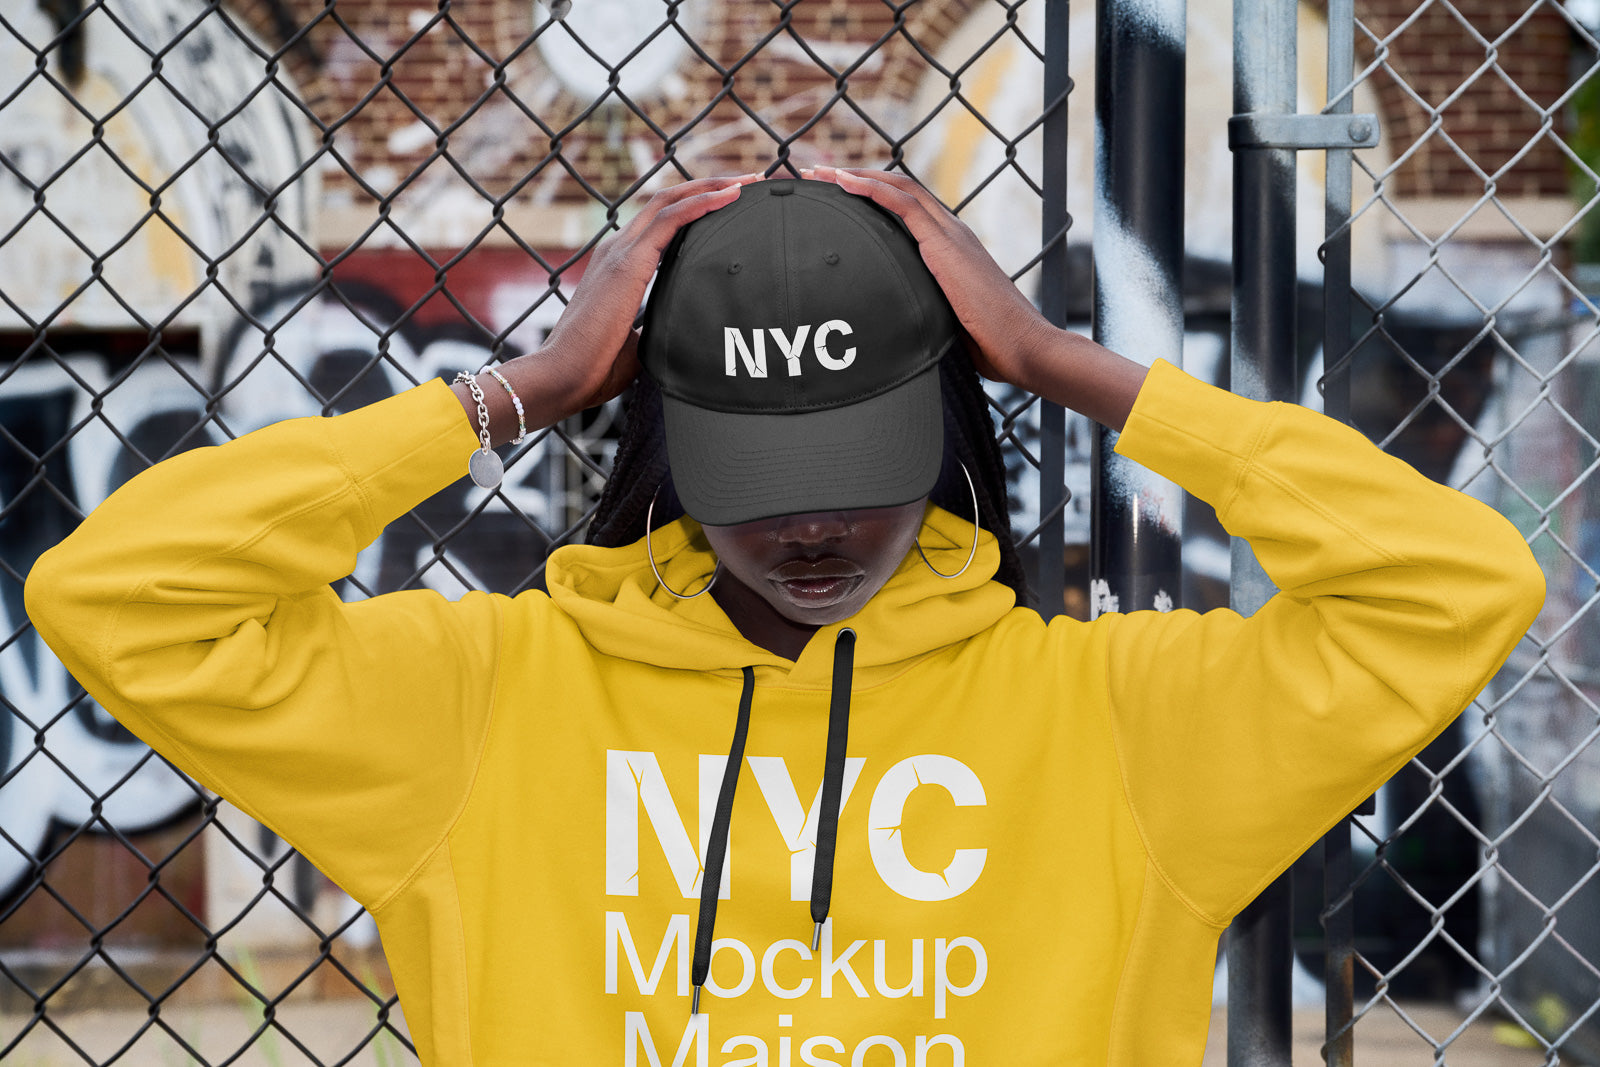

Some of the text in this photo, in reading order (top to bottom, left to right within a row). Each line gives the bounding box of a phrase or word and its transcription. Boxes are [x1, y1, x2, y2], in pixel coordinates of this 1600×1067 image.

[723, 319, 857, 379] NYC
[605, 749, 988, 902] NYC
[604, 911, 988, 1019] Mockup
